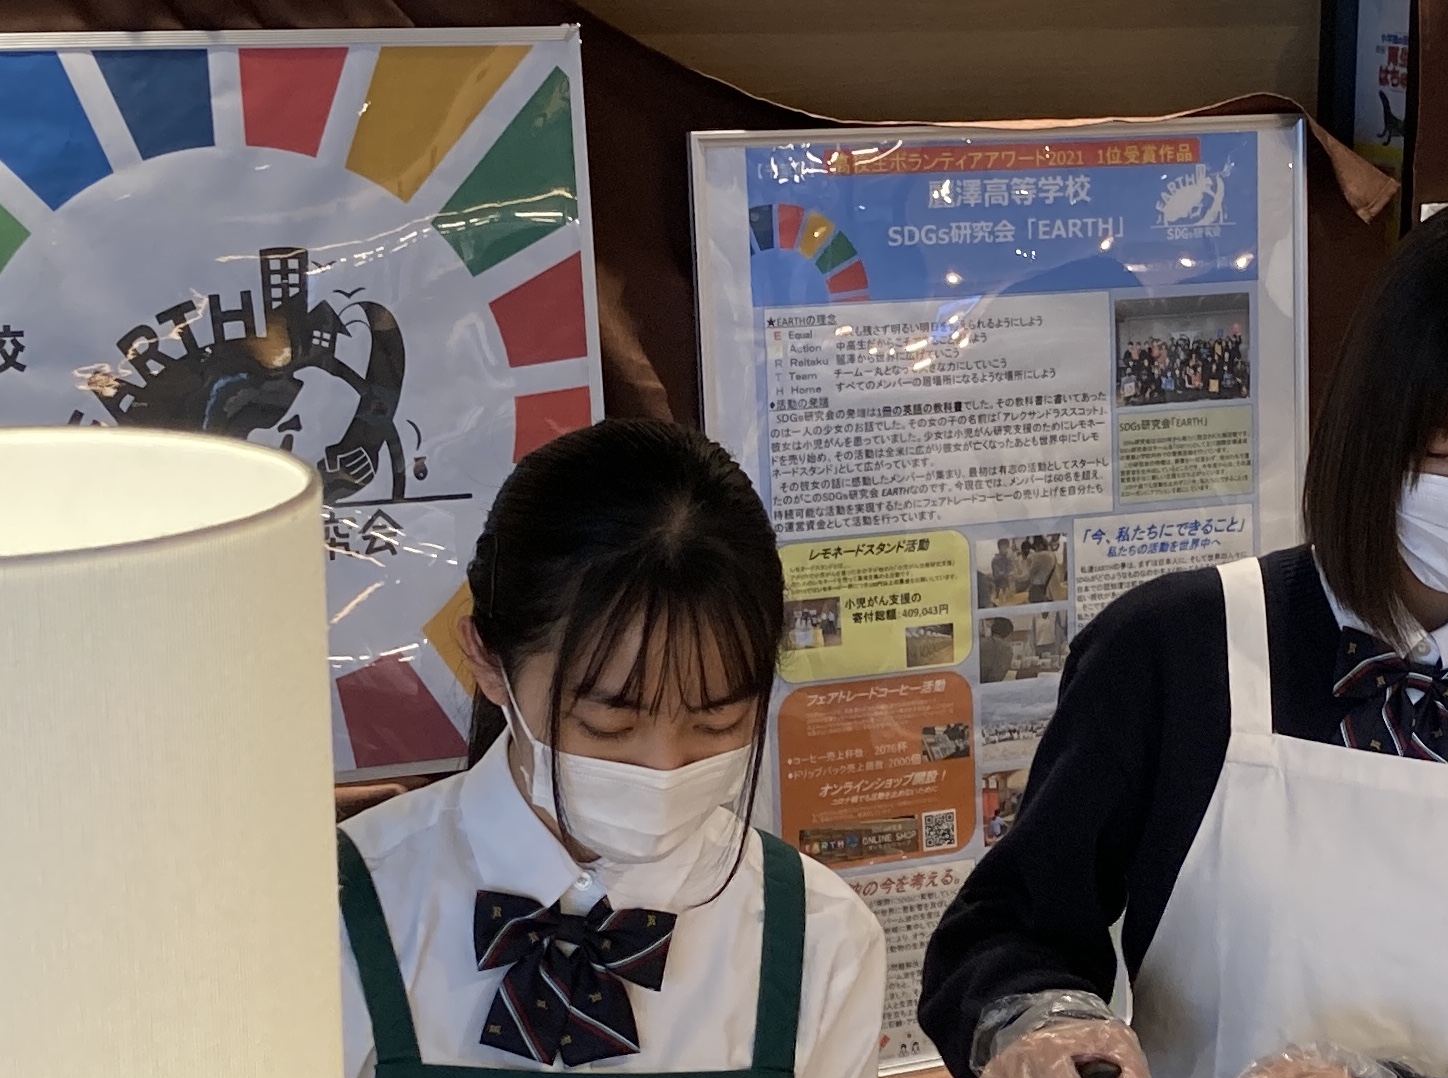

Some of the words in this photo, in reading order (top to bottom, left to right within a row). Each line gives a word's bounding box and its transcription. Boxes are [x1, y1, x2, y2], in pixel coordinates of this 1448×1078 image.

[1097, 143, 1193, 167] 1位受賞作品
[68, 290, 252, 427] ARTH
[808, 537, 930, 561] レモネードスタンド活動
[1106, 538, 1222, 560] 私たちの活動を世界中へ
[844, 591, 922, 611] 小児がん支援の
